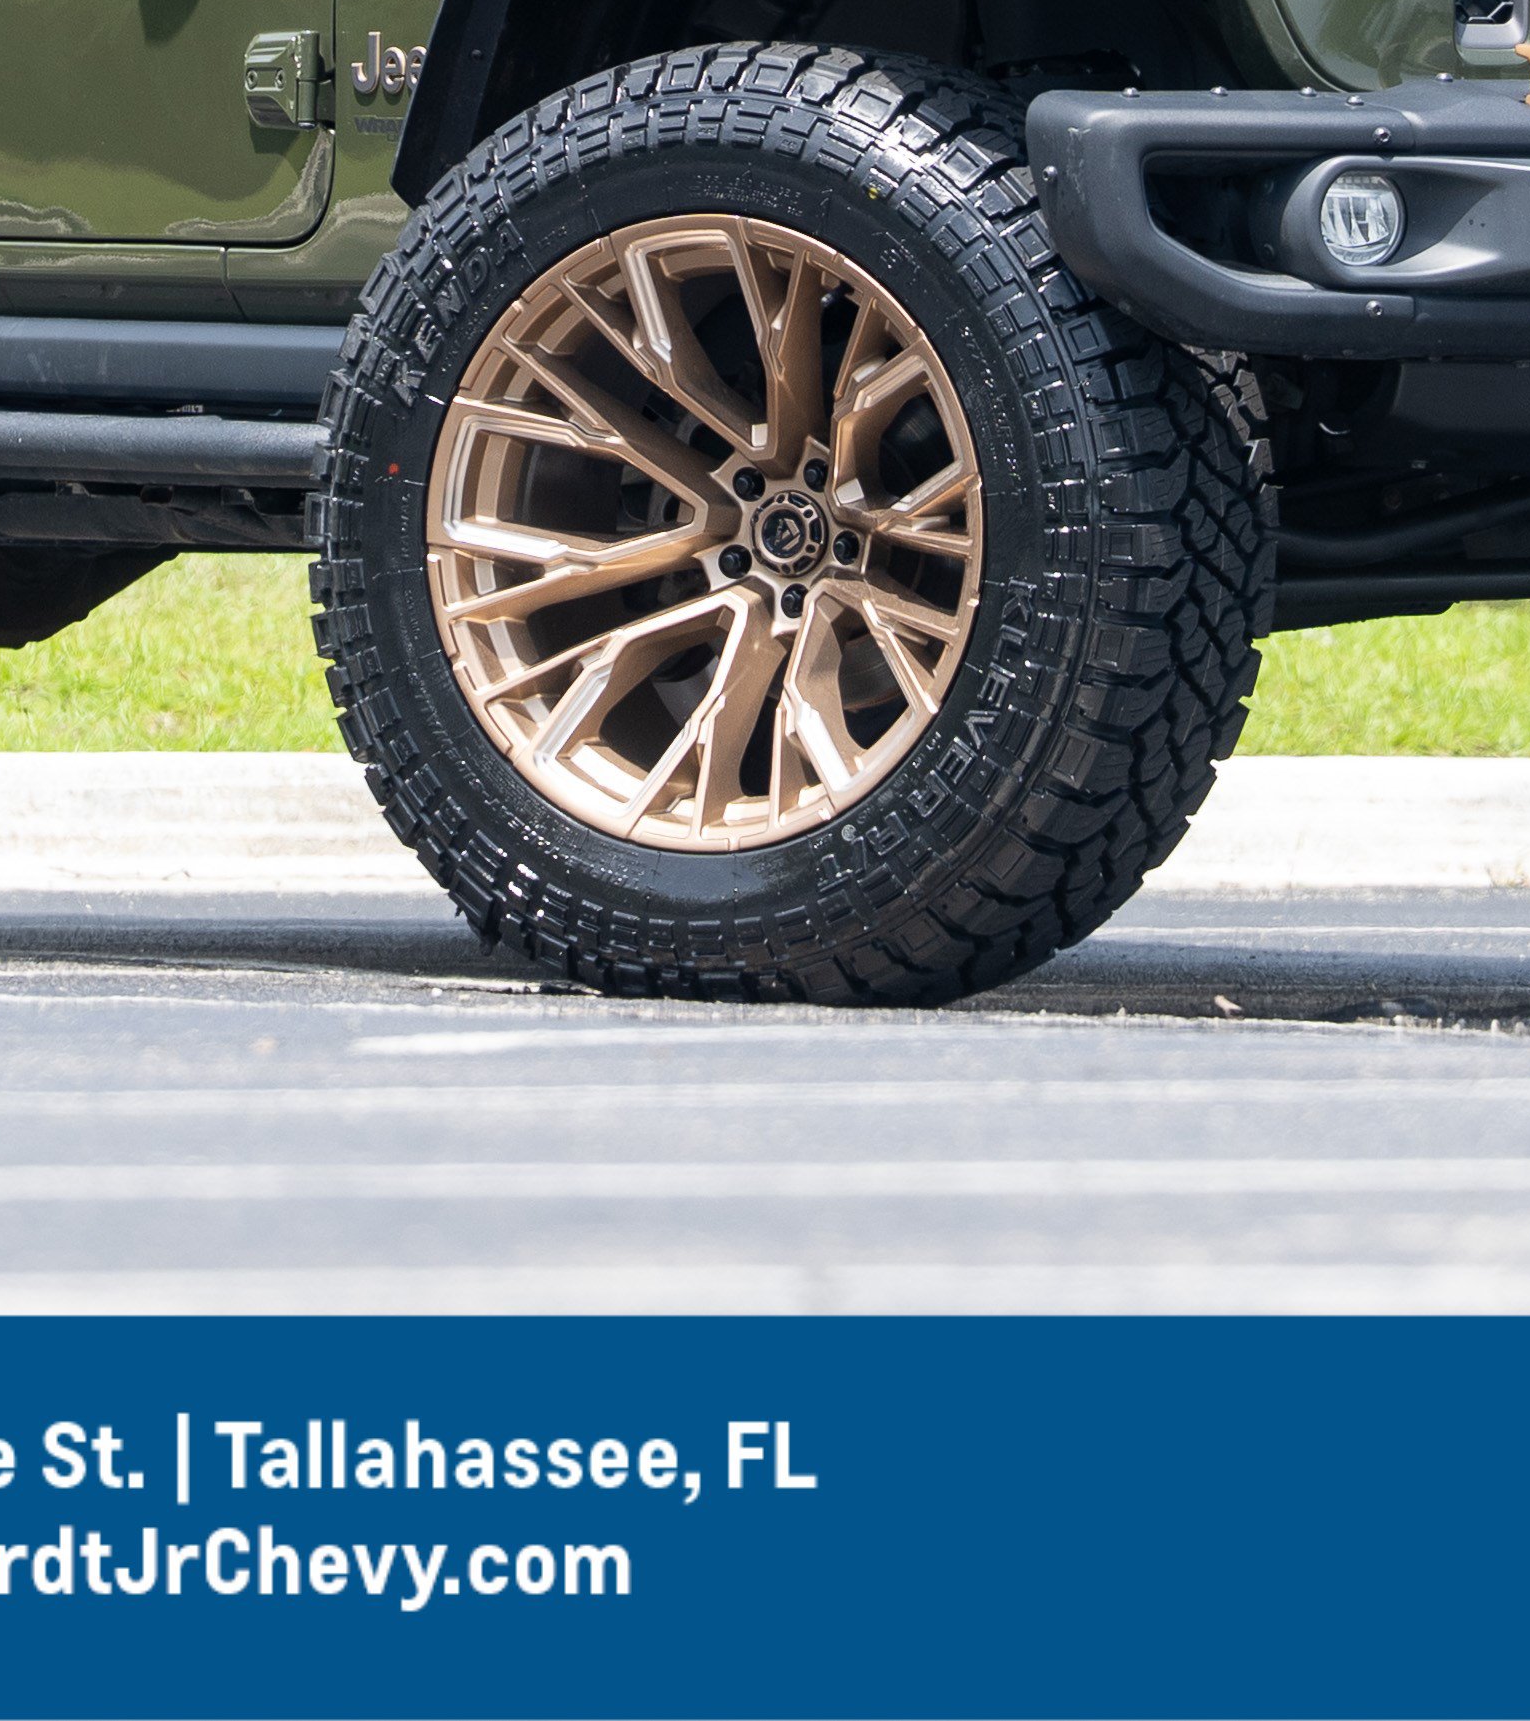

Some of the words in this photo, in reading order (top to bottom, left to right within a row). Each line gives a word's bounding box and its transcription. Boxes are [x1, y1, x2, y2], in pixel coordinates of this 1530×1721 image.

[351, 31, 427, 94] Jee
[390, 216, 526, 409] KENDA
[907, 577, 1038, 820] KLEVER
